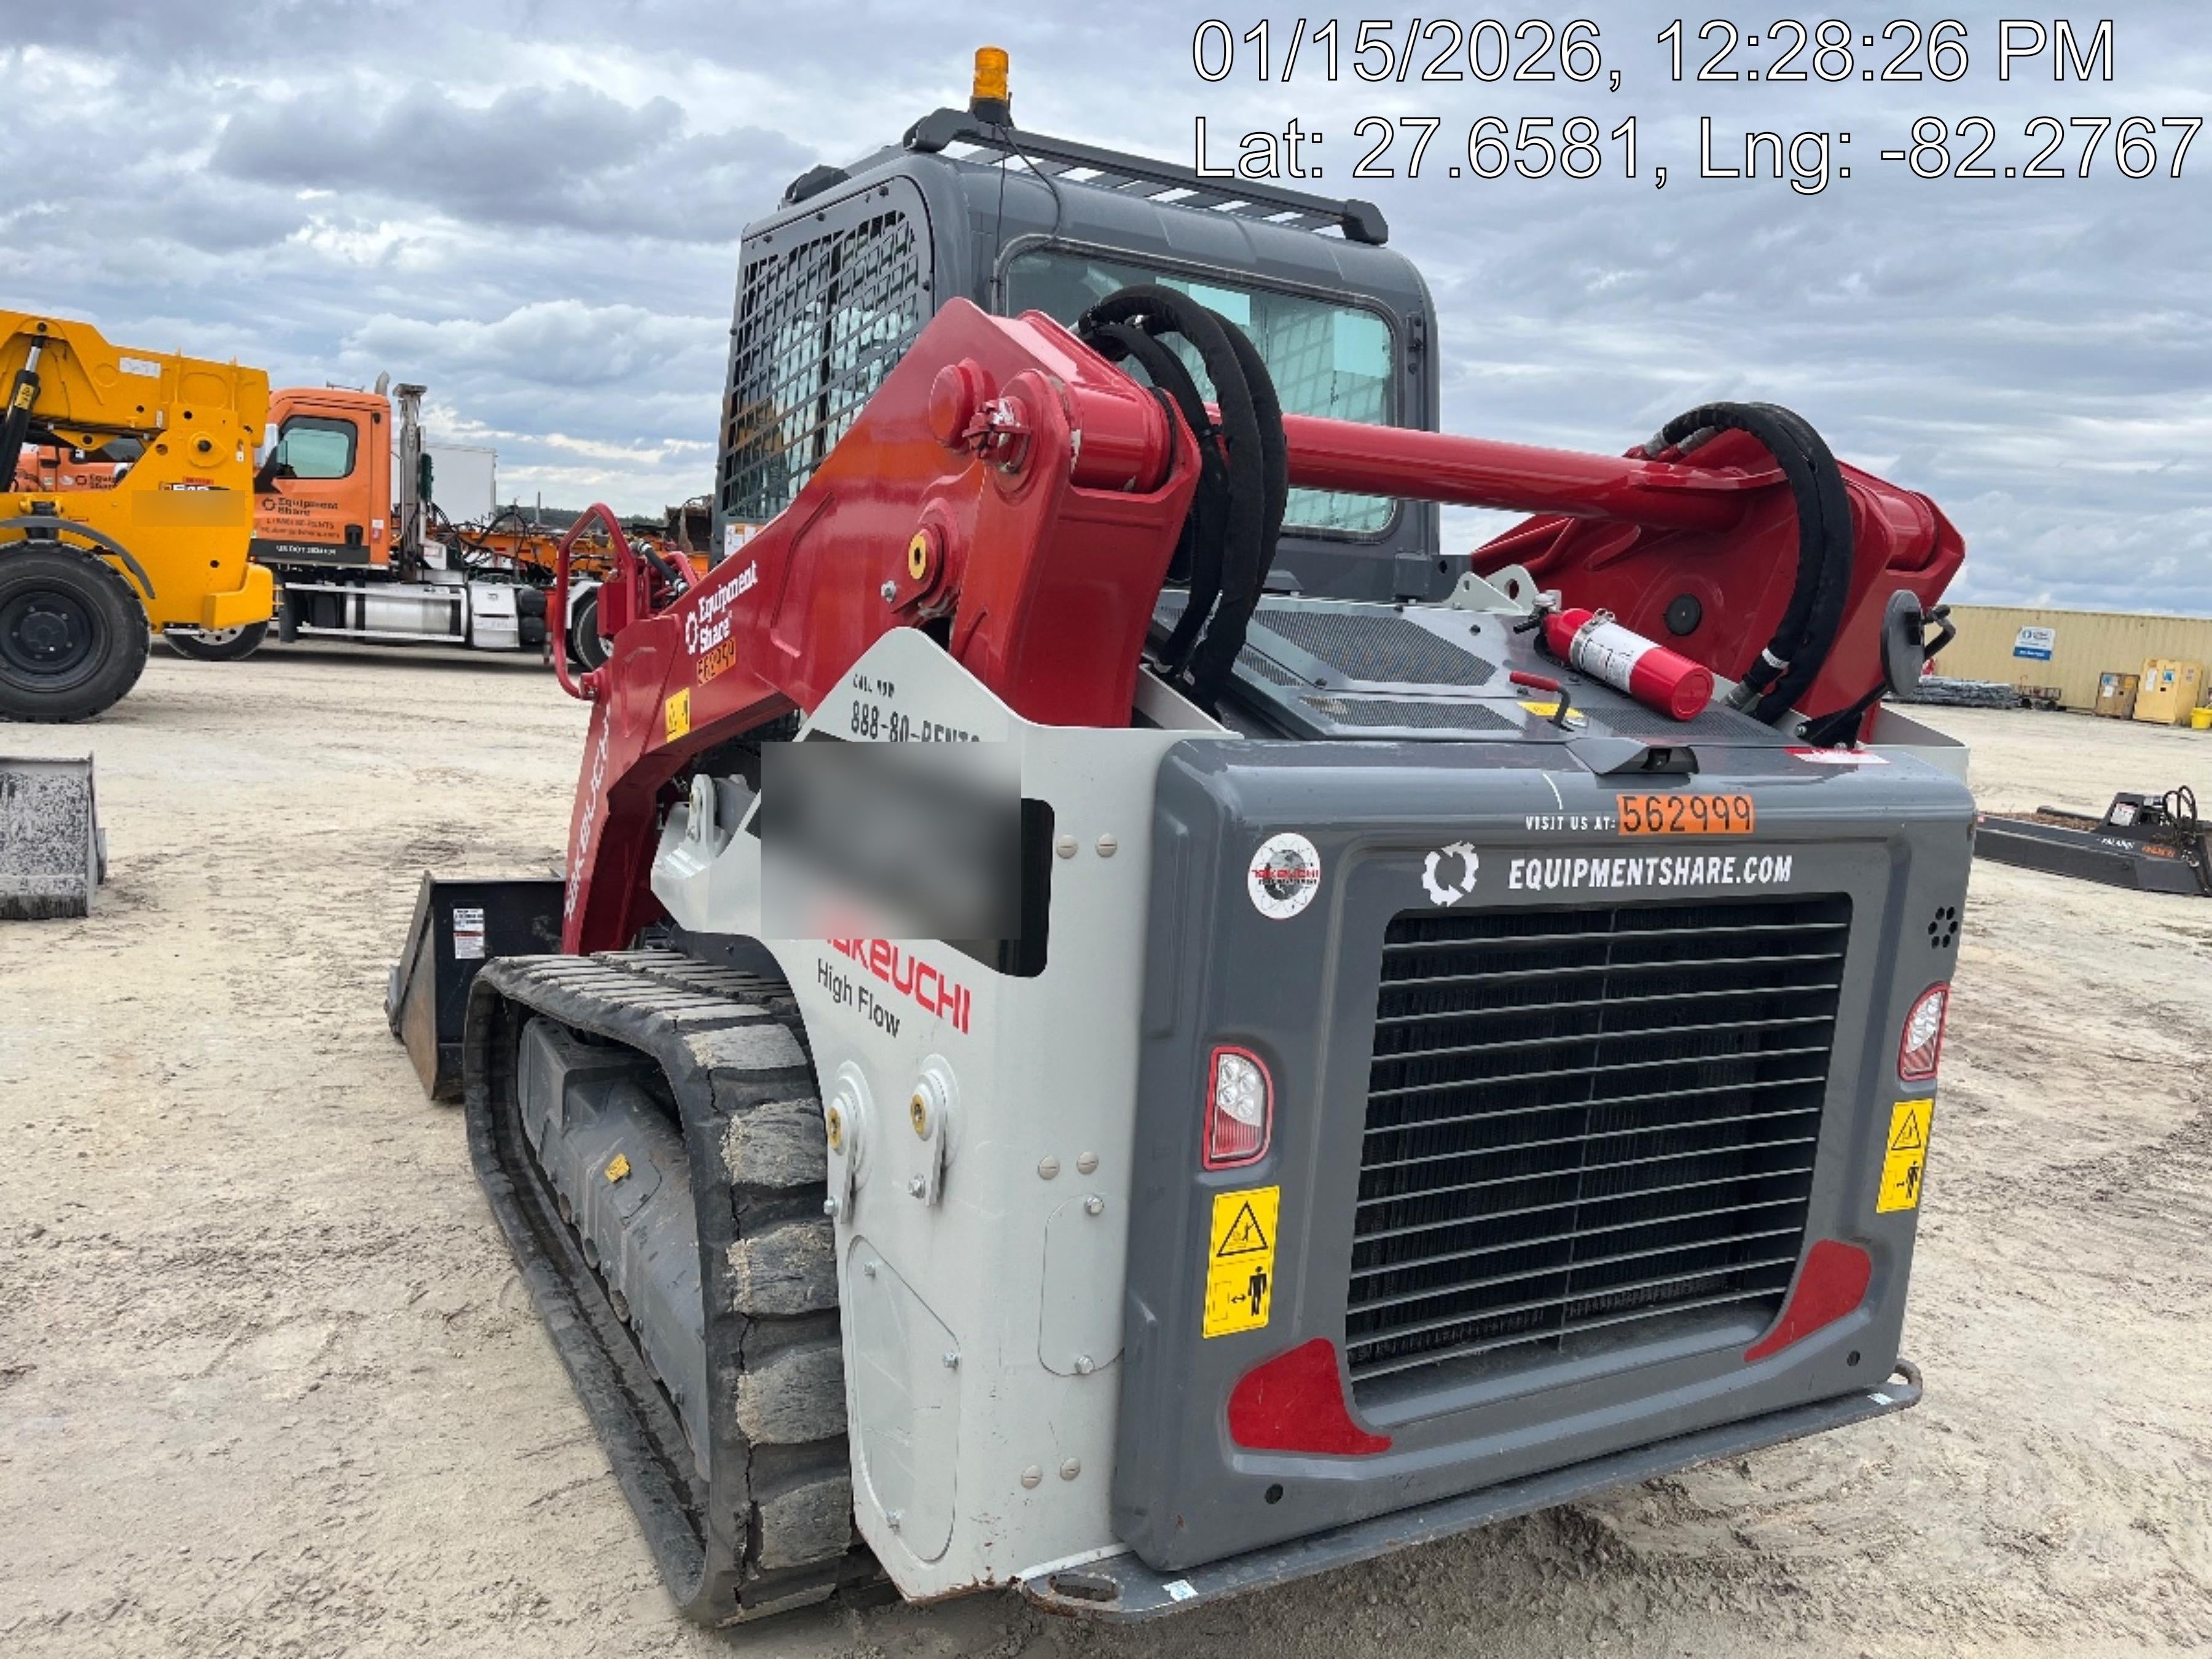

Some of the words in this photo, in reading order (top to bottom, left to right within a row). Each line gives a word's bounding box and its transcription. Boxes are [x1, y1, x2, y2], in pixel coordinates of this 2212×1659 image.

[698, 560, 758, 623] Equipment
[700, 616, 731, 654] Share
[1526, 816, 1563, 830] VISIT
[1571, 816, 1588, 830] US
[1594, 815, 1617, 830] AT:
[1622, 795, 1751, 833] 562999
[1508, 855, 1792, 891] EQUIPMENTSHARE.COM
[818, 958, 852, 1006] High
[858, 986, 900, 1038] Flow
